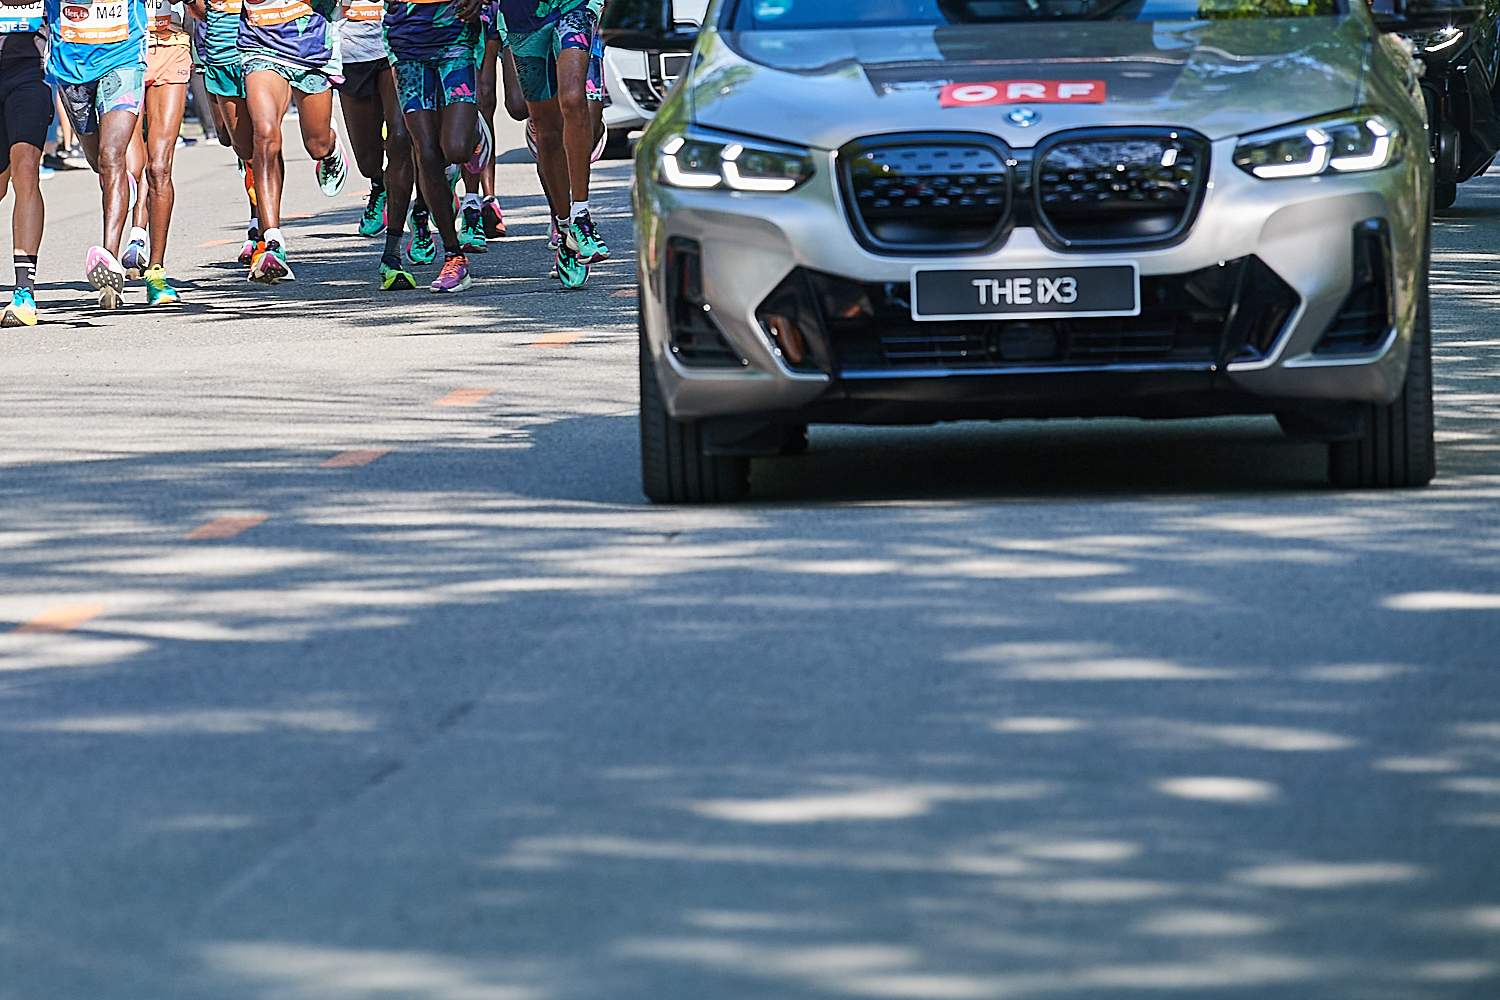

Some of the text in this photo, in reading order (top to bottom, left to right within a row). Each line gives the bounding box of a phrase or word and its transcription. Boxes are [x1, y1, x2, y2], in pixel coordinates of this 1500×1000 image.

[96, 5, 122, 19] M42
[951, 82, 1095, 102] ORF
[971, 277, 1033, 305] THE
